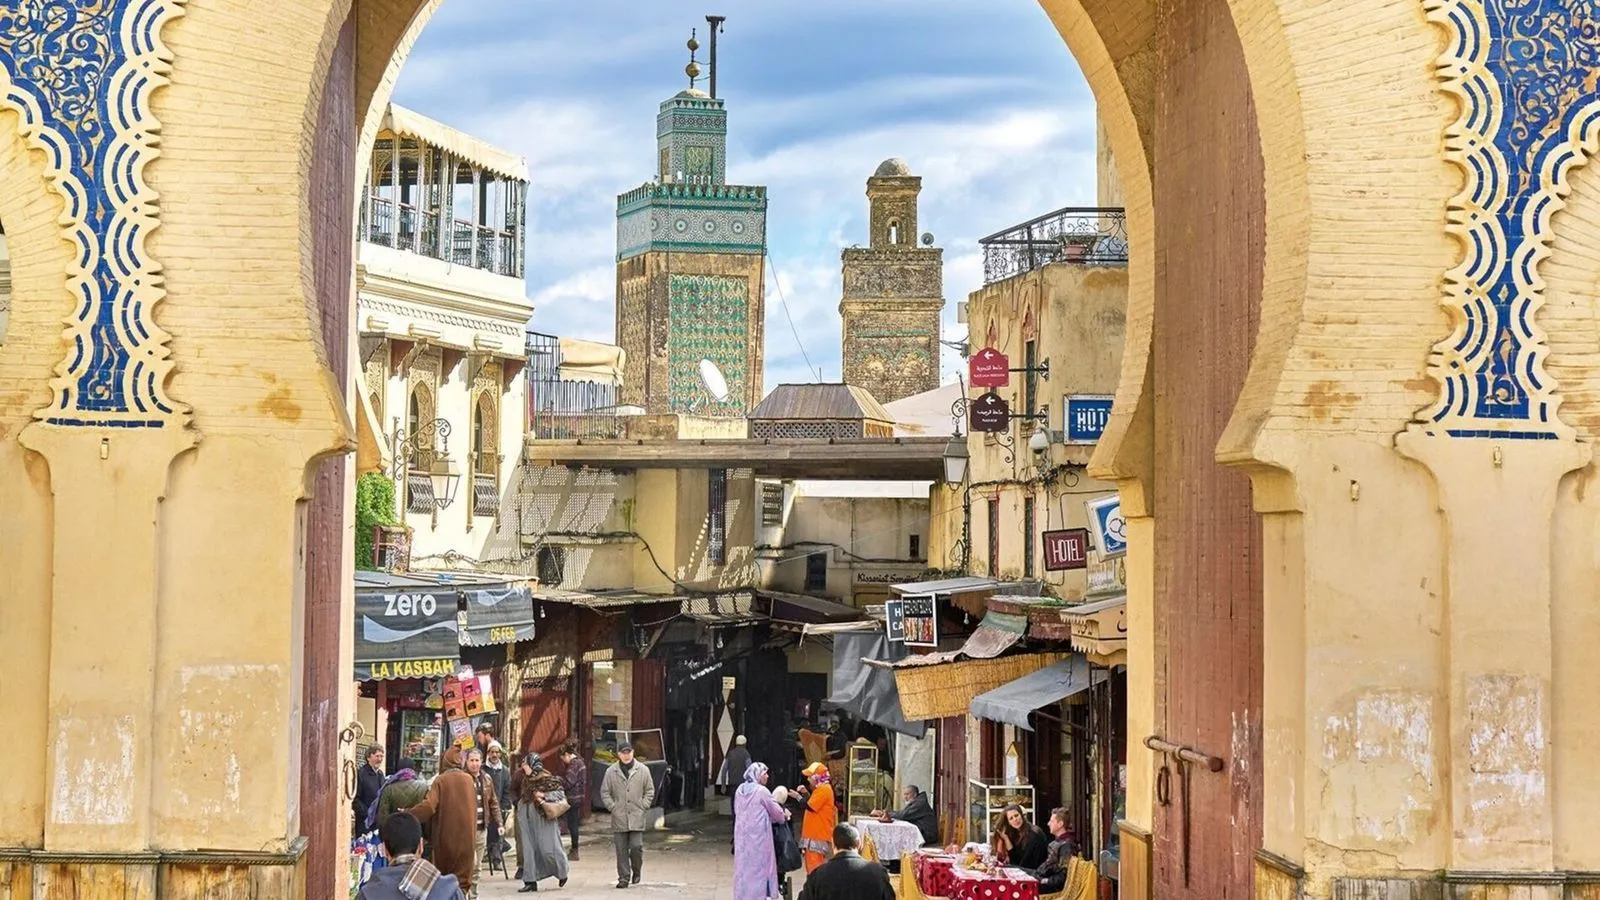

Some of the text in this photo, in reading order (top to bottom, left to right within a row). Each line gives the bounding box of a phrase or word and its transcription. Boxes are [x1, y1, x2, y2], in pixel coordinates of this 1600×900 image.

[1077, 408, 1111, 432] HOT
[1052, 538, 1085, 562] HOTEL
[384, 594, 437, 617] zero
[490, 627, 501, 641] DE
[892, 621, 904, 631] CA
[371, 659, 455, 678] LA KASBAH
